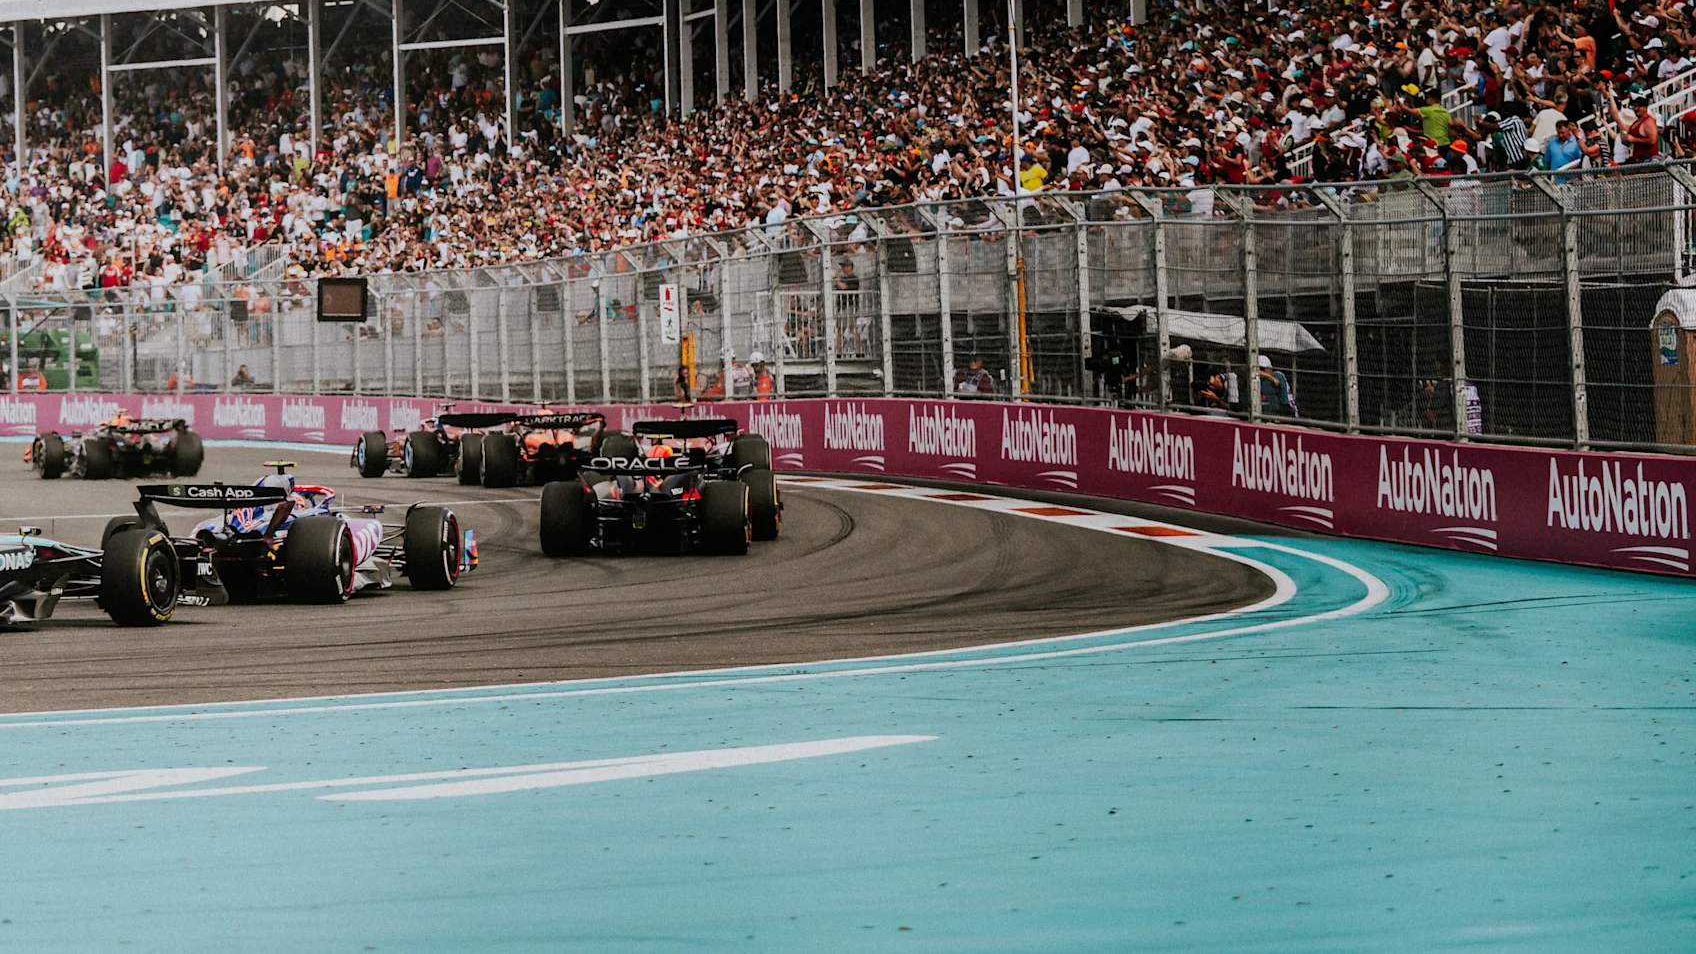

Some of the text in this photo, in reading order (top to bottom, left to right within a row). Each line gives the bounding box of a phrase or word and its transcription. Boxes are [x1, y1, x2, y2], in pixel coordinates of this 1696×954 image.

[213, 397, 266, 427] AutoNation
[282, 397, 325, 429] AutoNation
[341, 399, 378, 431] AutoNation
[749, 403, 803, 448] AutoNation
[824, 402, 884, 451] AutoNation
[909, 403, 976, 458] AutoNation
[1001, 407, 1078, 466] AutoNation
[1108, 414, 1195, 482] AutoNation
[590, 456, 691, 470] ORACLE
[1232, 426, 1334, 502] AutoNation
[1377, 444, 1498, 522] AutoNation
[187, 486, 223, 498] Cash
[225, 486, 254, 499] App
[1547, 456, 1690, 540] AutoNation
[197, 562, 213, 576] IWC
